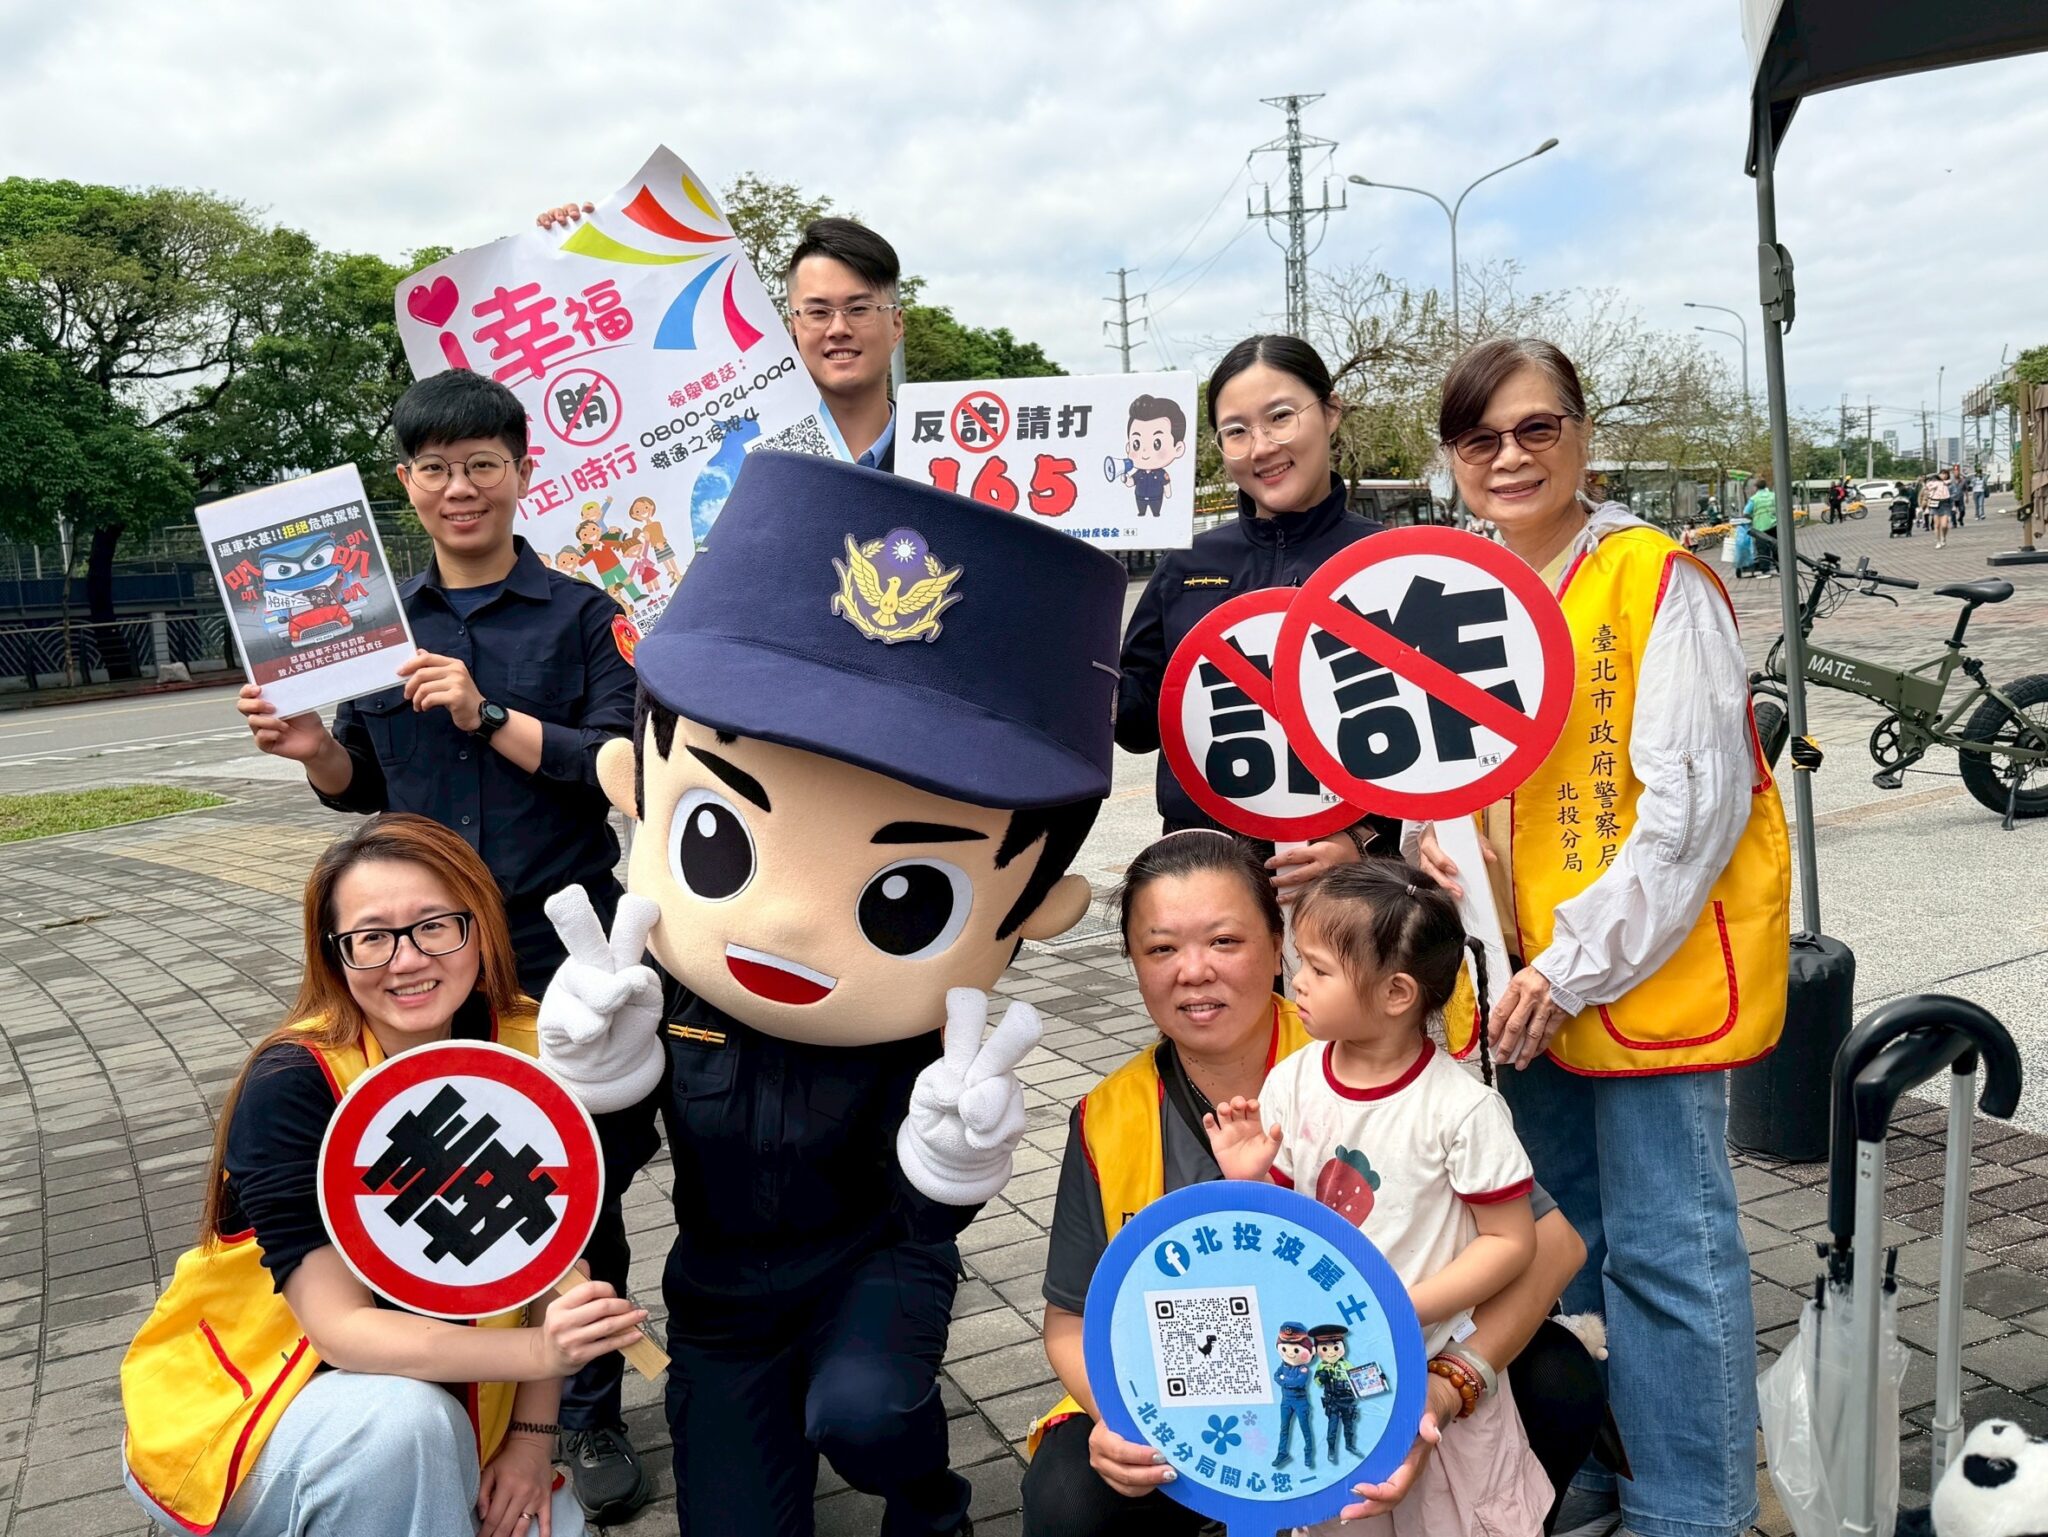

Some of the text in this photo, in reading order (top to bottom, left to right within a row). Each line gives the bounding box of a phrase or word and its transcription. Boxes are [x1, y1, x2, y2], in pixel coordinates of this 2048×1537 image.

[472, 278, 633, 380] 幸福
[640, 356, 796, 448] 0800-024-099
[912, 402, 1092, 443] 反詐請打
[929, 454, 1078, 517] 165
[224, 560, 262, 591] 叭
[1311, 575, 1526, 780] 詐
[1587, 623, 1621, 868] 臺北市政府警察局
[1557, 782, 1584, 874] 北投分局
[360, 1083, 559, 1266] 毒
[1192, 1222, 1367, 1326] 北投波麗士
